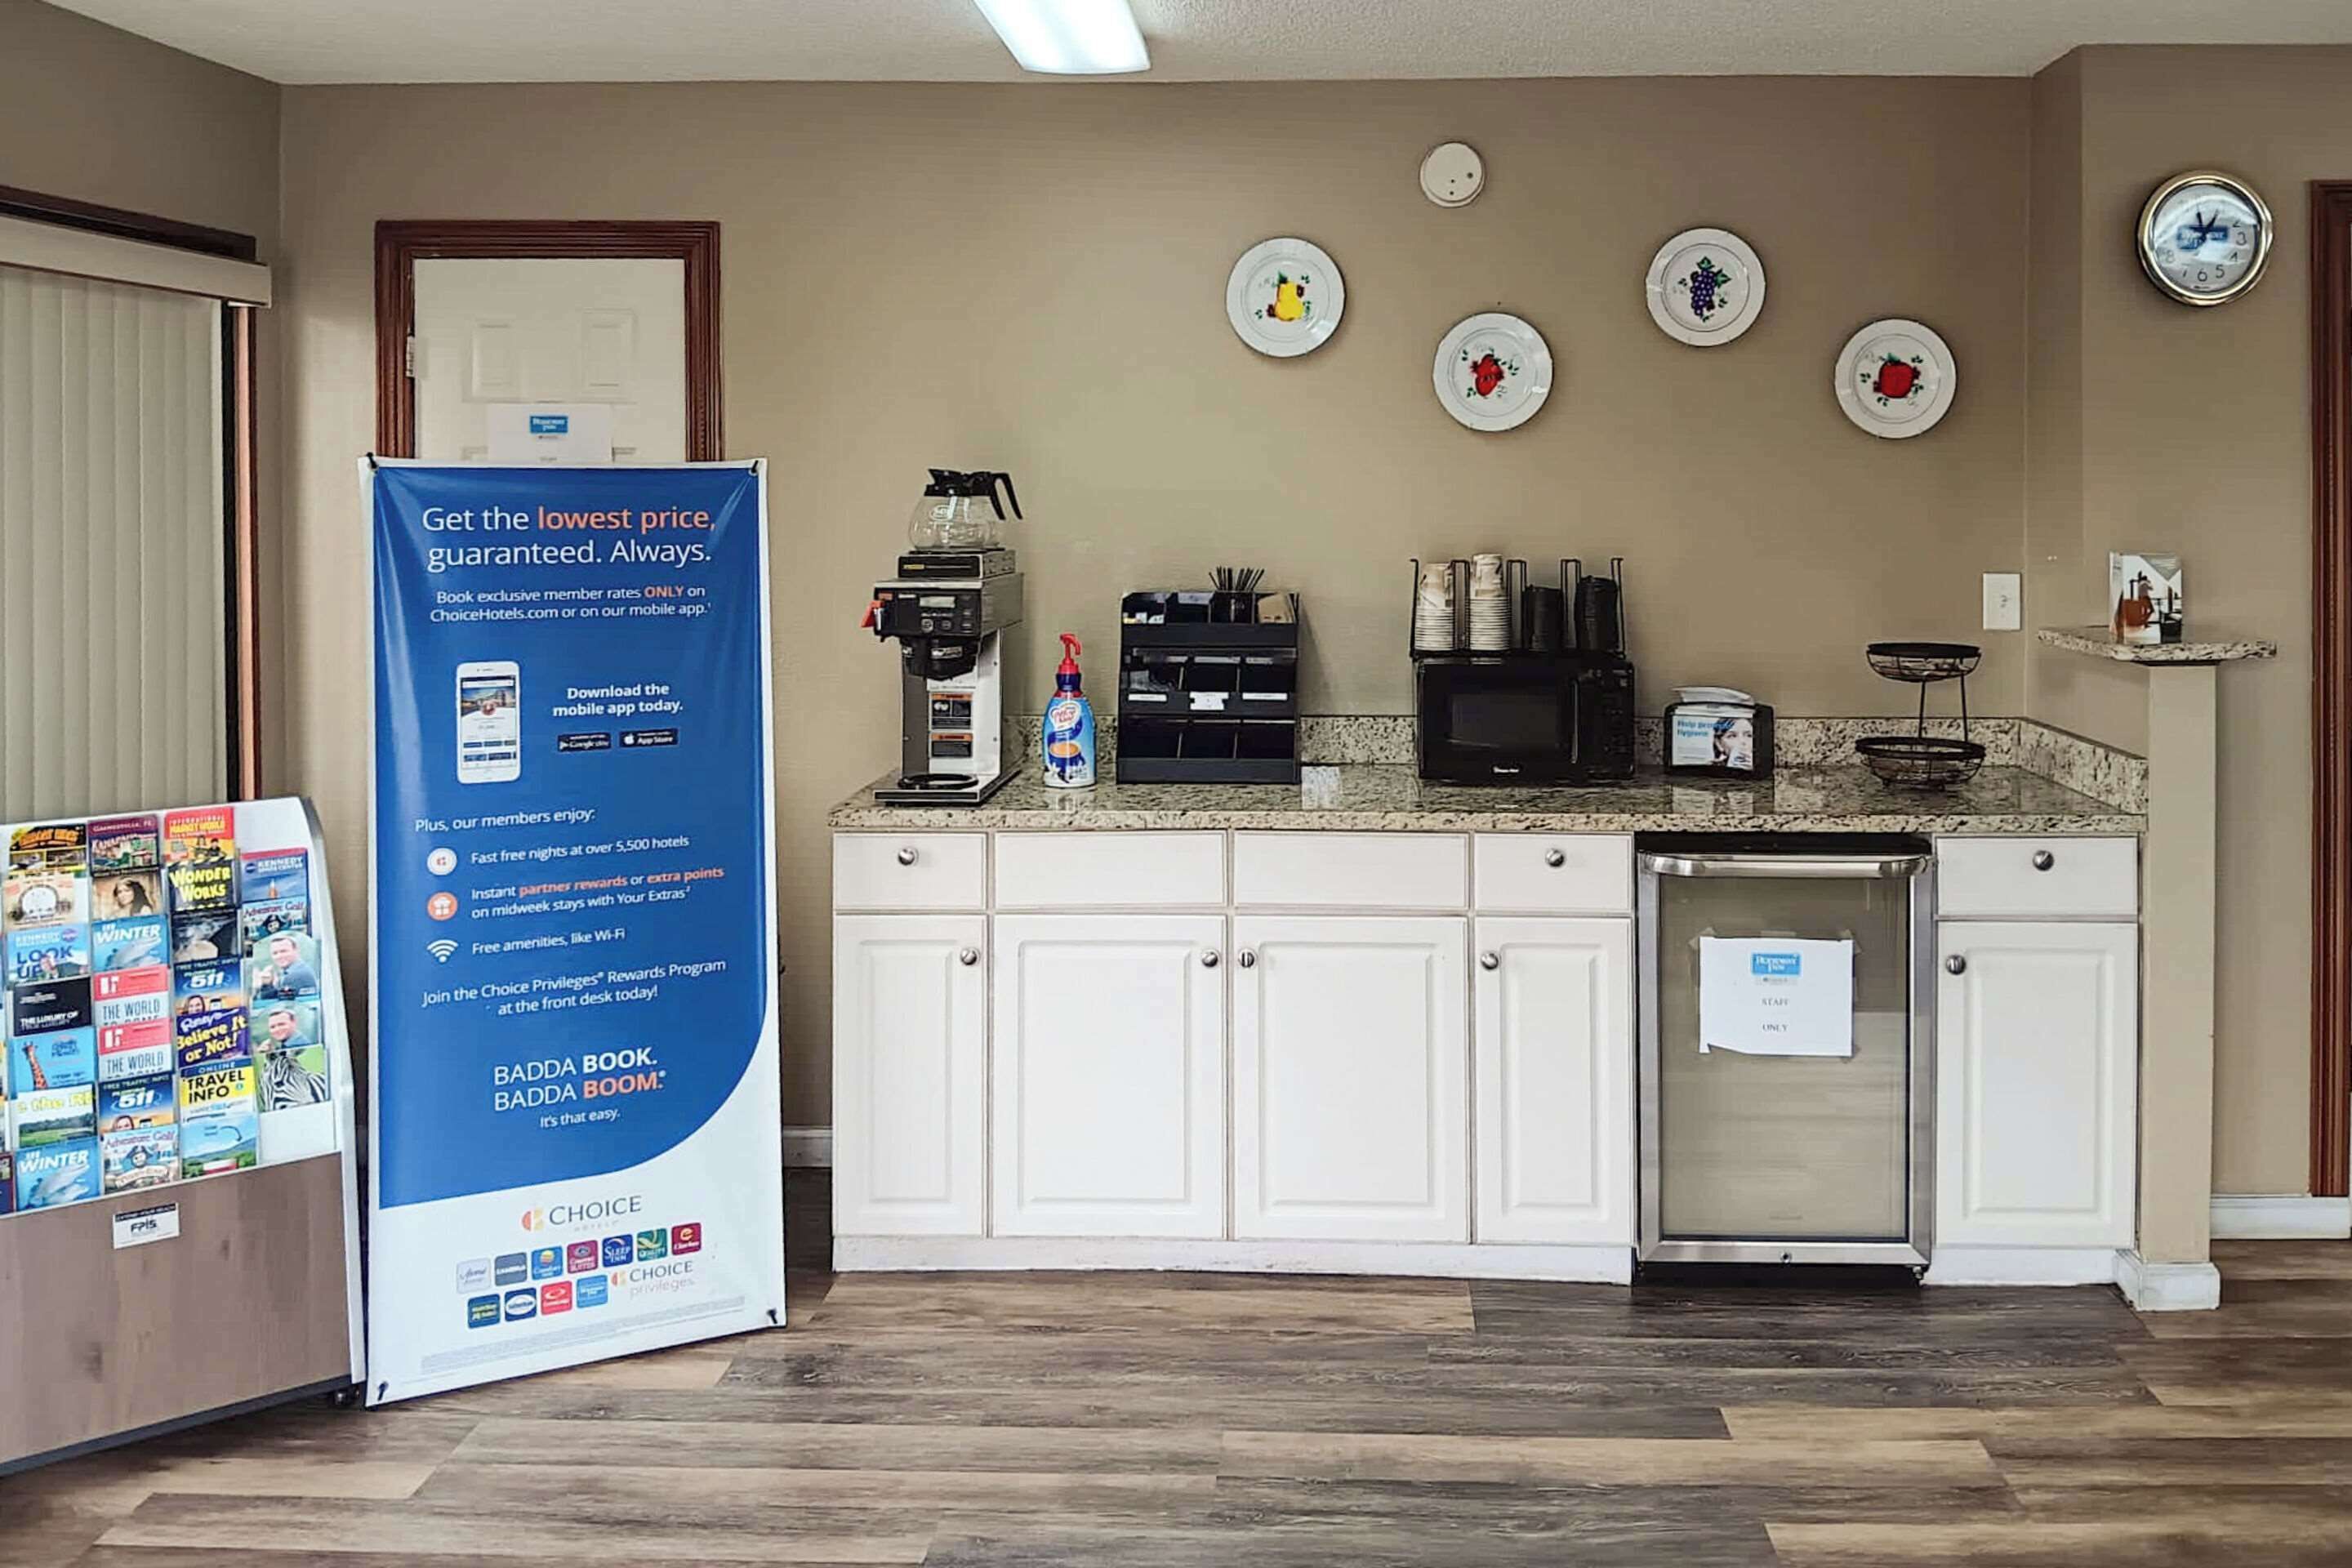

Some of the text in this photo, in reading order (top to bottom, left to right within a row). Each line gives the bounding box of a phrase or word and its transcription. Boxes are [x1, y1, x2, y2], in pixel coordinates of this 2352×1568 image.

[2236, 232, 2247, 246] 3
[2198, 269, 2207, 282] 6
[2216, 264, 2225, 278] 5
[422, 506, 716, 535] Get the lowest price,
[427, 540, 711, 572] guaranteed. Always.
[437, 585, 706, 604] Book exclusive member rates ONLY on
[430, 607, 559, 623] ChoiceHotels.com
[561, 608, 577, 618] or
[580, 607, 599, 618] on
[602, 605, 626, 617] our
[630, 602, 676, 617] mobile
[567, 683, 670, 701] Download the
[553, 699, 684, 717] mobile app today.
[637, 736, 653, 746] App
[415, 807, 596, 833] Plus, our members enjoy:
[471, 835, 690, 864] Fast free nights at over 5,500 hotels
[169, 866, 231, 888] WONDER
[471, 866, 724, 899] Instant partner rewards or extra points
[180, 884, 226, 903] WORKS
[471, 906, 489, 919] on
[492, 900, 550, 916] midweek
[553, 898, 586, 914] stays
[587, 893, 615, 906] with
[617, 889, 646, 904] Your
[93, 924, 163, 945] WINTER
[472, 927, 626, 955] Free amenities, like Wi-Fi
[16, 945, 74, 965] LOOK
[421, 990, 450, 1008] Join
[453, 986, 479, 1001] the
[481, 978, 530, 998] Choice
[608, 965, 666, 983] Rewards
[668, 959, 727, 981] Program
[103, 999, 161, 1020] THE WORLD
[497, 983, 658, 1015] at the front desk today!
[1762, 998, 1788, 1006] STAFF
[20, 1017, 35, 1027] THE
[1762, 1023, 1788, 1032] ONLY
[176, 1015, 247, 1051] Believe It
[185, 1031, 239, 1062] or Not!
[107, 1059, 123, 1075] THE
[127, 1051, 164, 1070] WORLD
[198, 1061, 236, 1074] ONLINE
[494, 1048, 657, 1086] BADDA BOOK.
[187, 1070, 246, 1091] TRAVEL
[188, 1085, 230, 1105] INFO
[494, 1084, 577, 1111] BADDA
[541, 1107, 621, 1129] It's that easy.
[18, 1150, 88, 1174] WINTER
[549, 1195, 642, 1226] CHOICE
[604, 1245, 631, 1259] SLEEP
[630, 1260, 693, 1282] CHOICE
